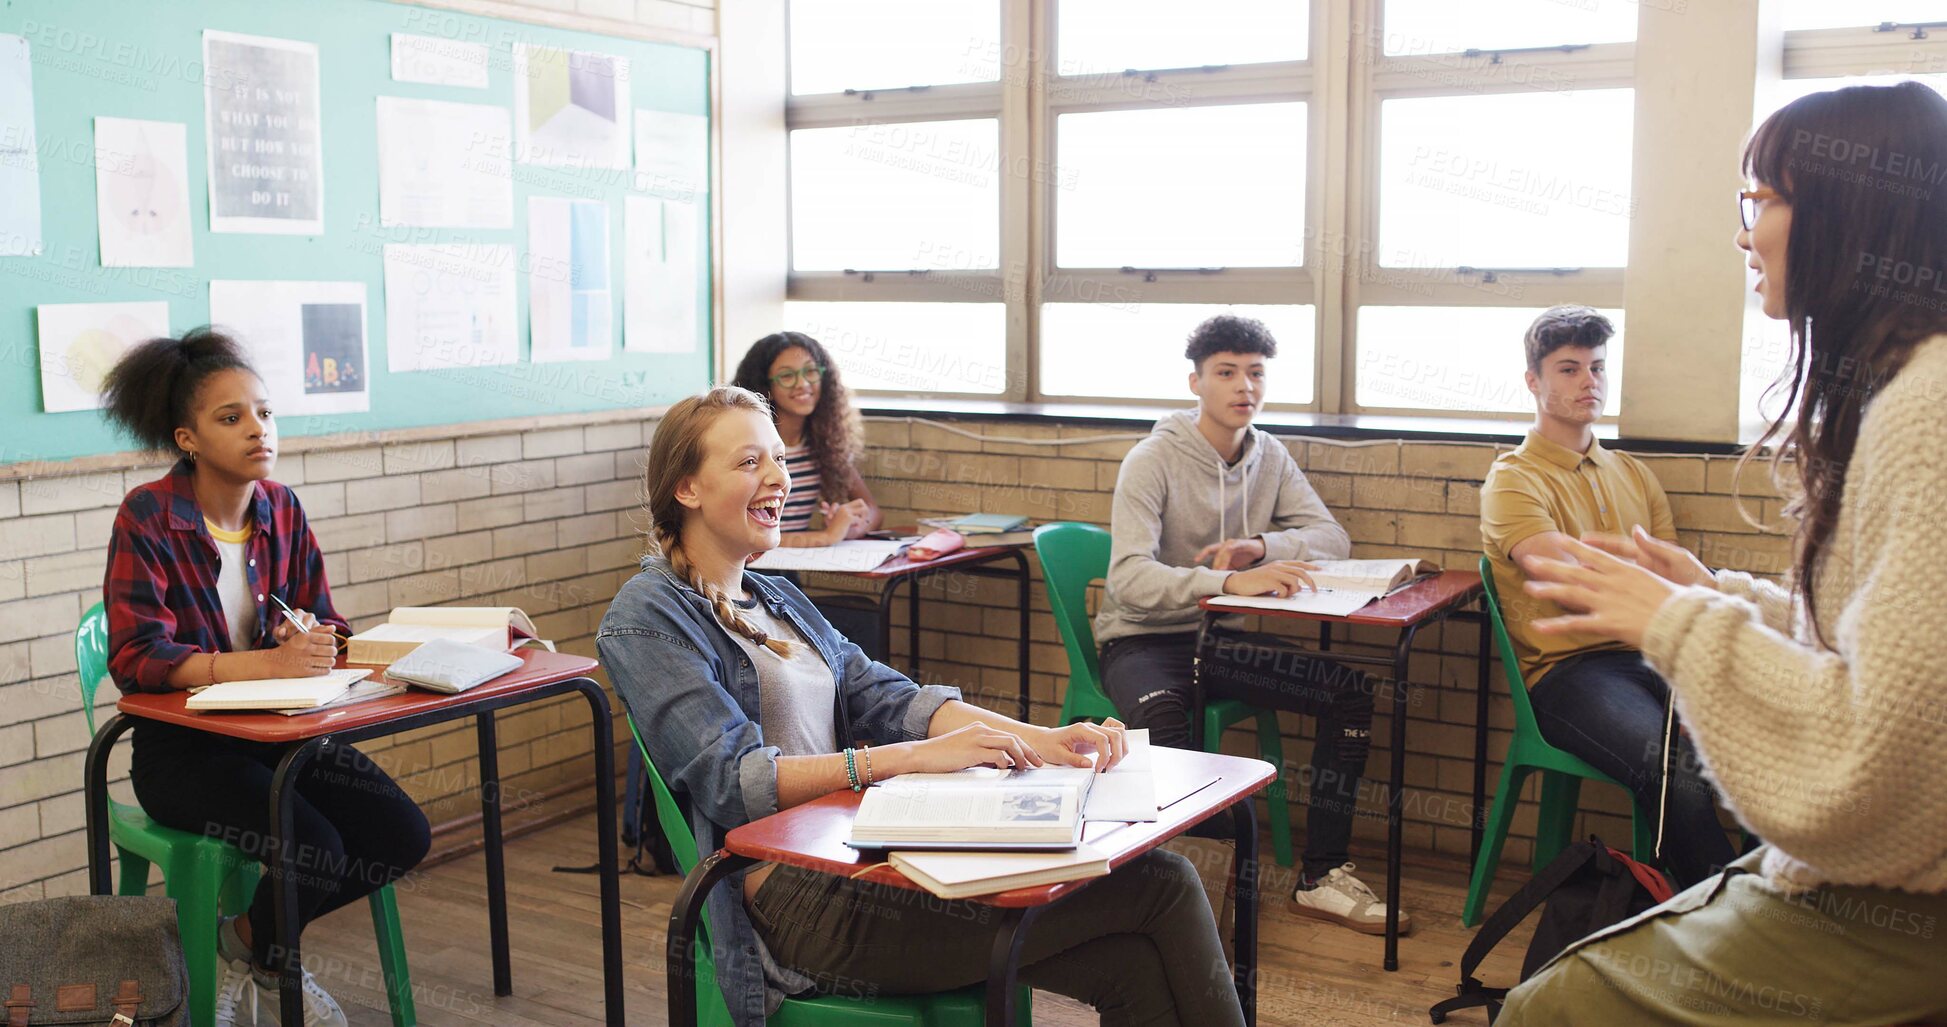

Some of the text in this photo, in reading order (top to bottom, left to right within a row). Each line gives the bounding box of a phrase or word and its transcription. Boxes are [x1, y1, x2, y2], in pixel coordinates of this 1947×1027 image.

[256, 87, 270, 101] IS
[275, 89, 299, 104] NOT
[220, 110, 259, 127] WHAT
[266, 113, 288, 128] YOU
[221, 136, 249, 152] BUT
[255, 139, 284, 154] HOW
[231, 164, 309, 181] CHOOSE TO
[252, 190, 289, 207] DO IT
